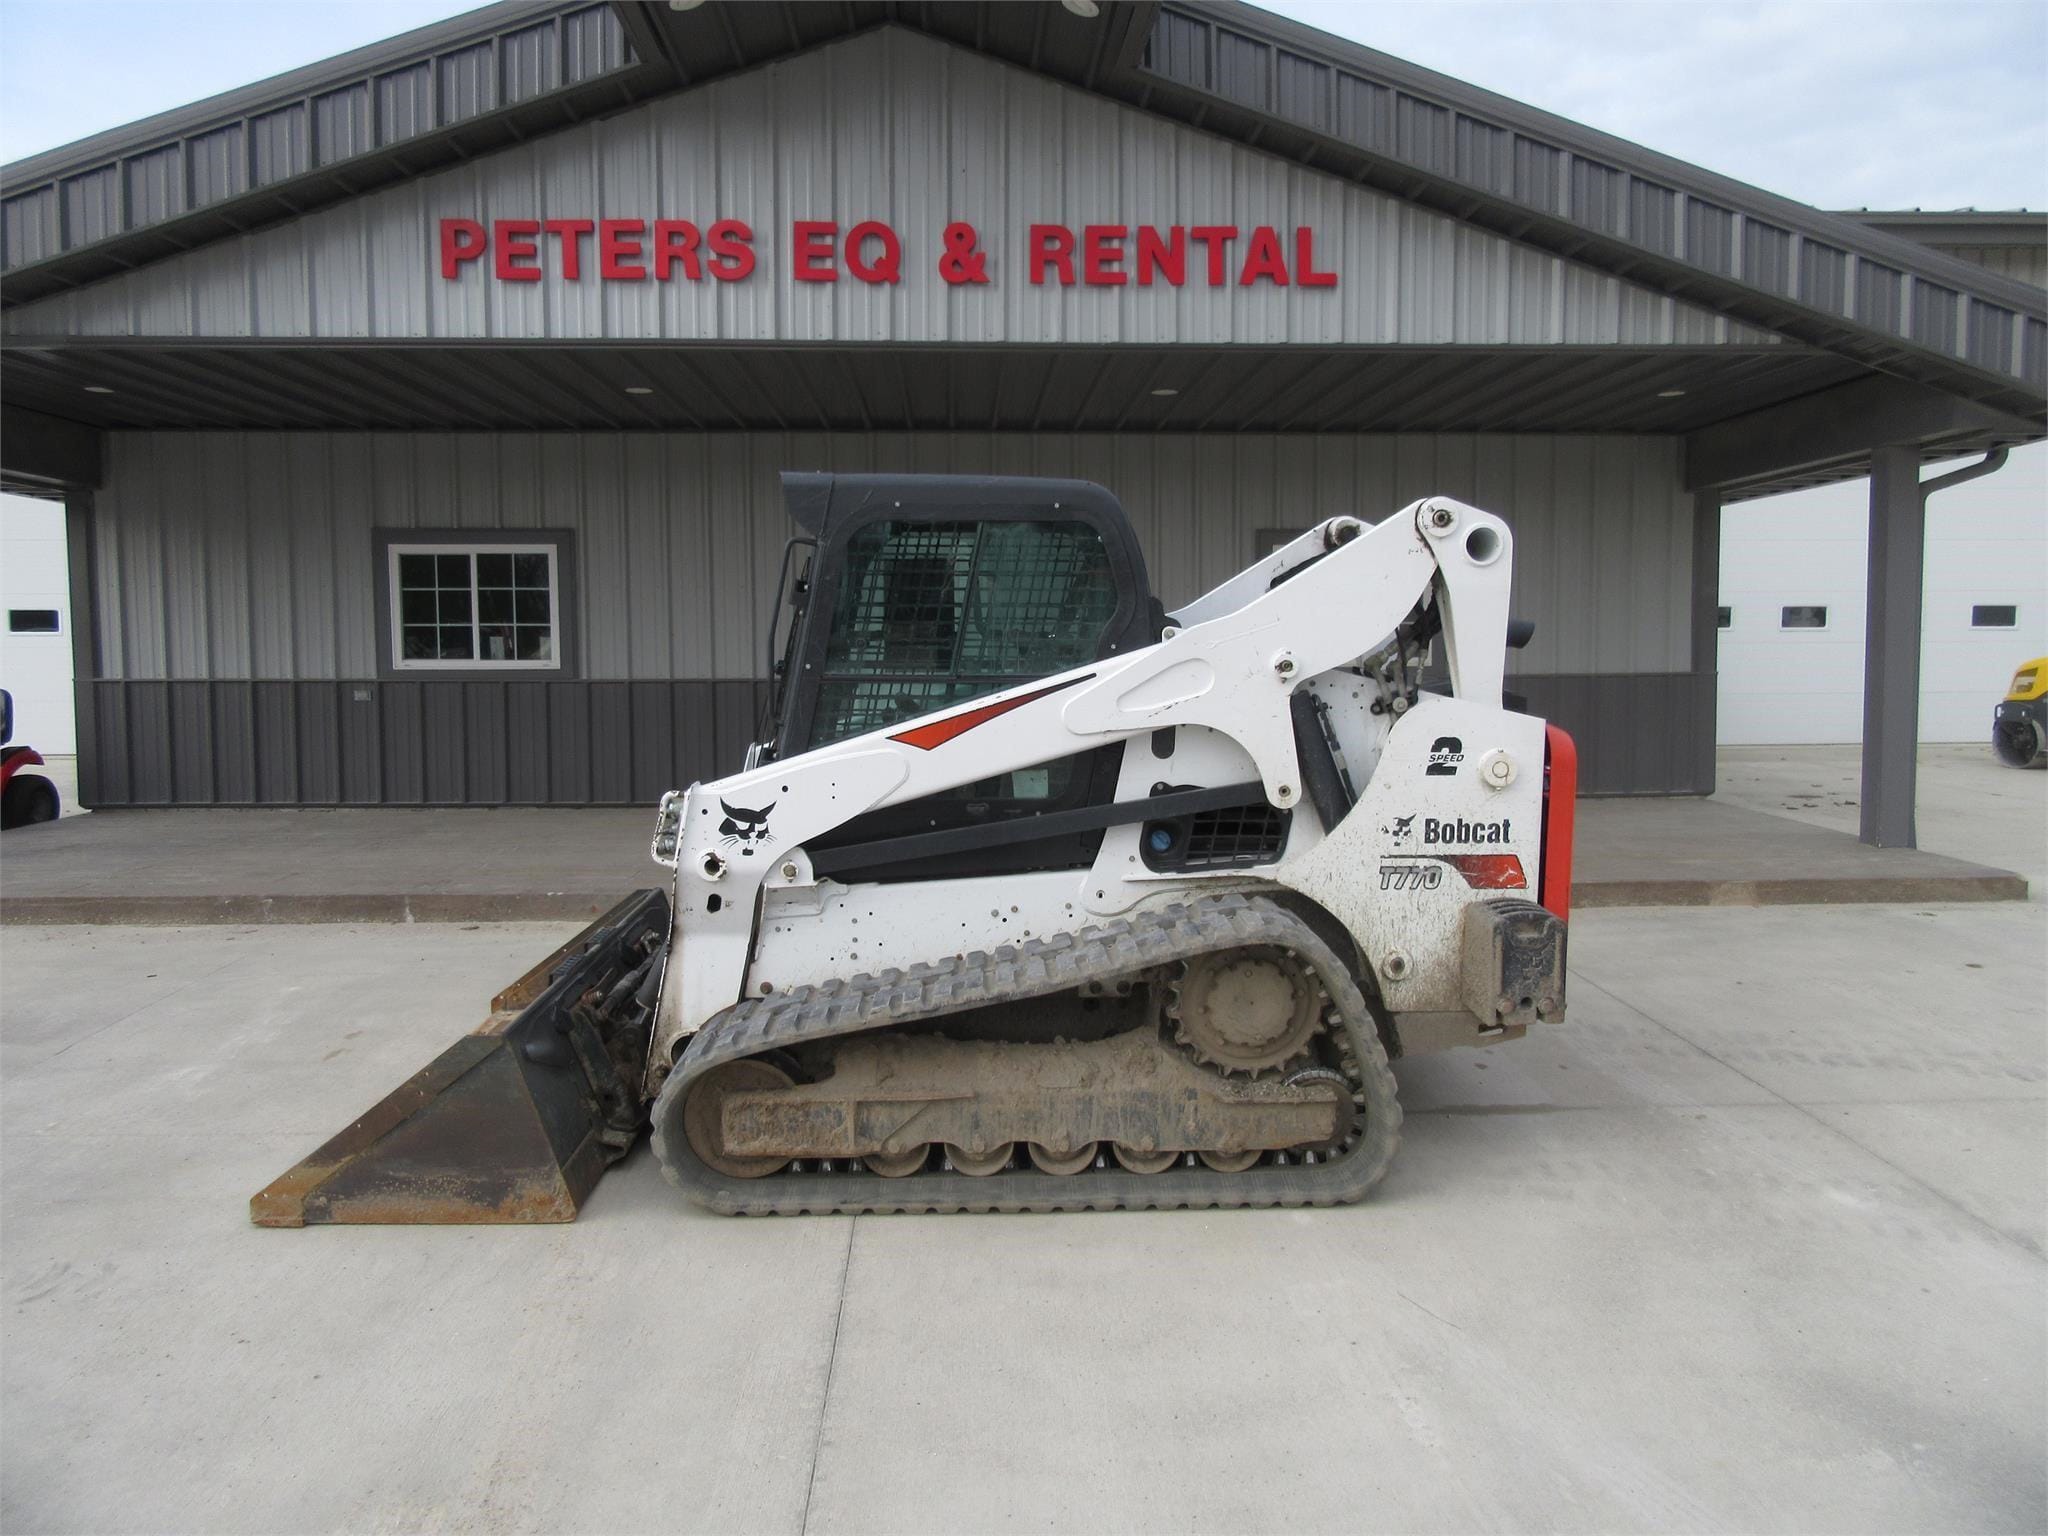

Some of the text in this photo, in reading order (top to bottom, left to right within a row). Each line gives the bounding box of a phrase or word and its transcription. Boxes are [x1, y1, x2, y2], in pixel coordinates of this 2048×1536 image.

[440, 218, 1338, 287] PETERS EQ & RENTAL
[1425, 736, 1463, 776] 2
[1428, 754, 1465, 763] SPEED
[1424, 818, 1511, 844] Bobcat
[1379, 865, 1443, 890] T770
